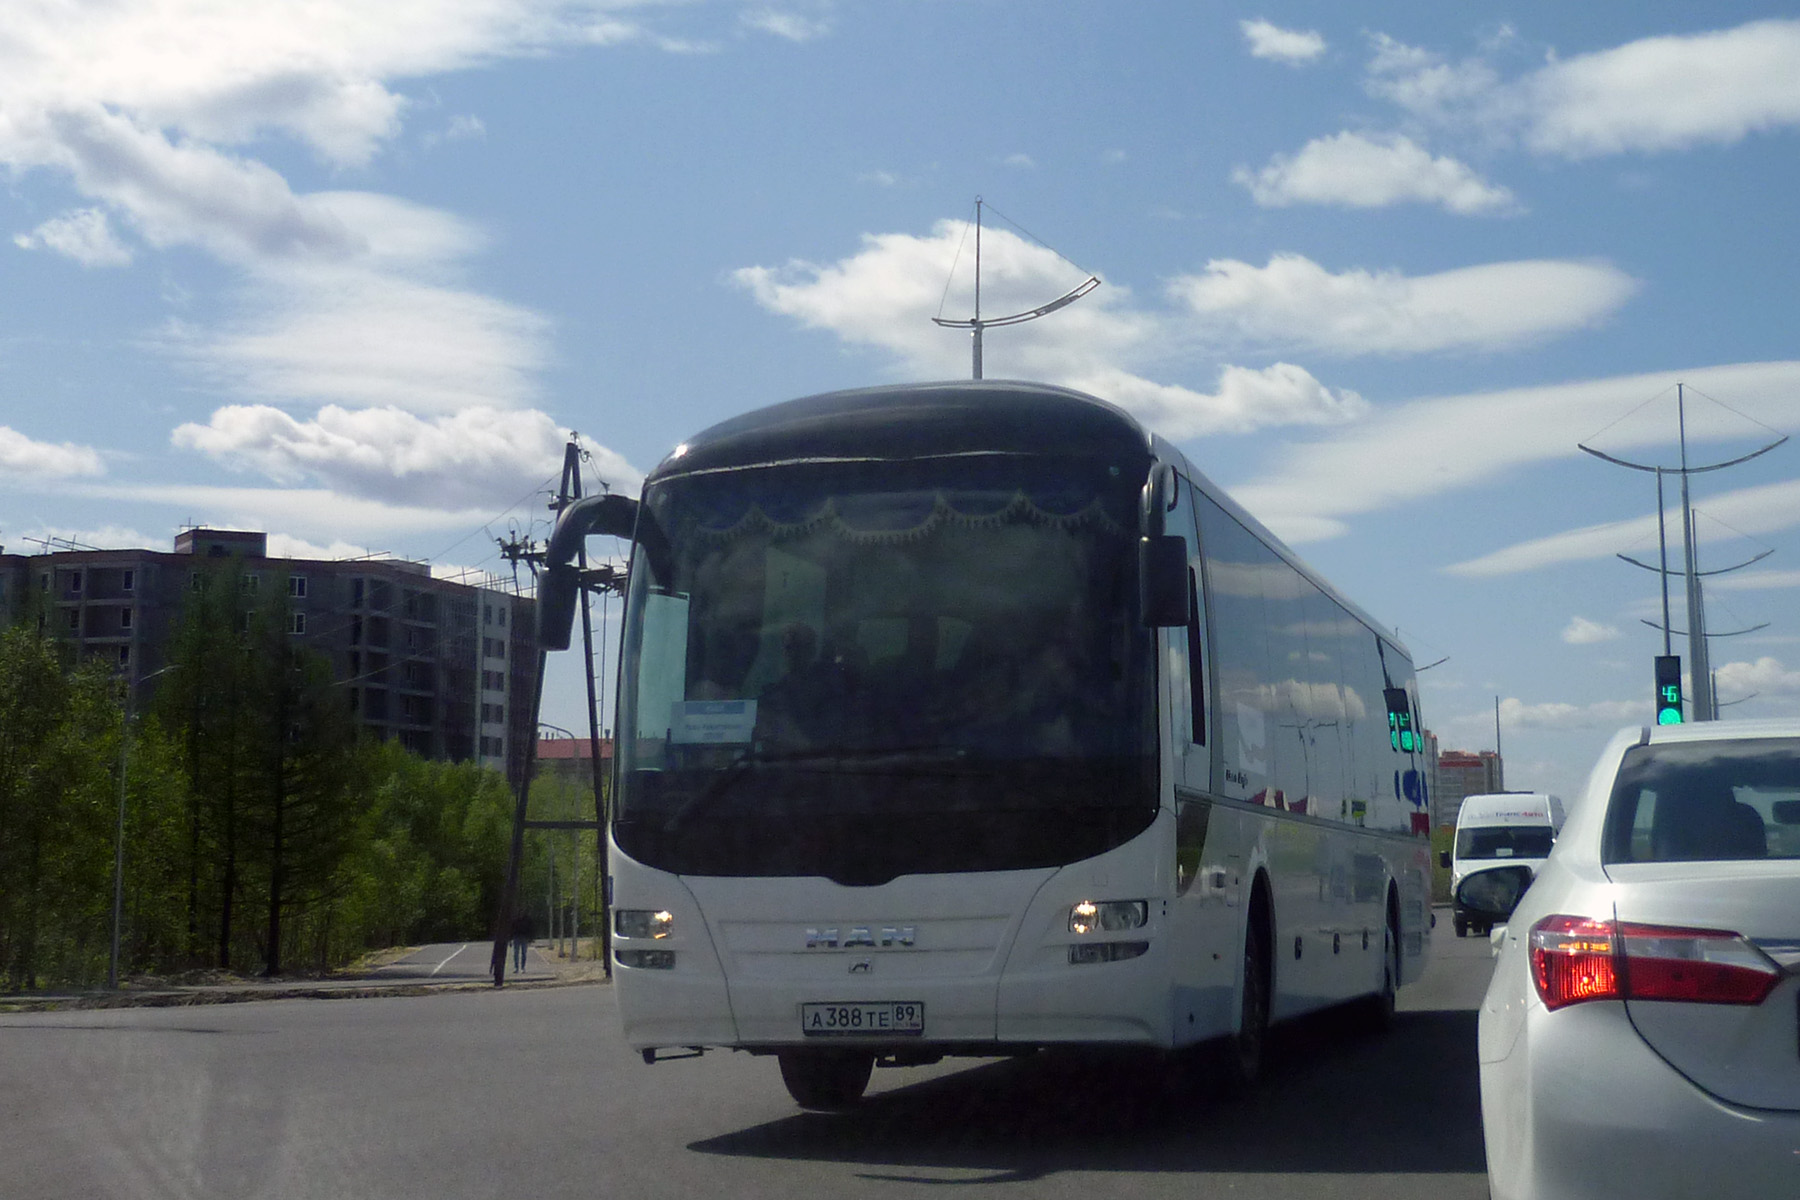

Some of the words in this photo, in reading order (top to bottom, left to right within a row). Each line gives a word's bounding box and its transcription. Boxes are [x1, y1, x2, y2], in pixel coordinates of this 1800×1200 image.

[1662, 685, 1677, 703] 46
[805, 926, 915, 949] MAN
[895, 1005, 916, 1022] 89
